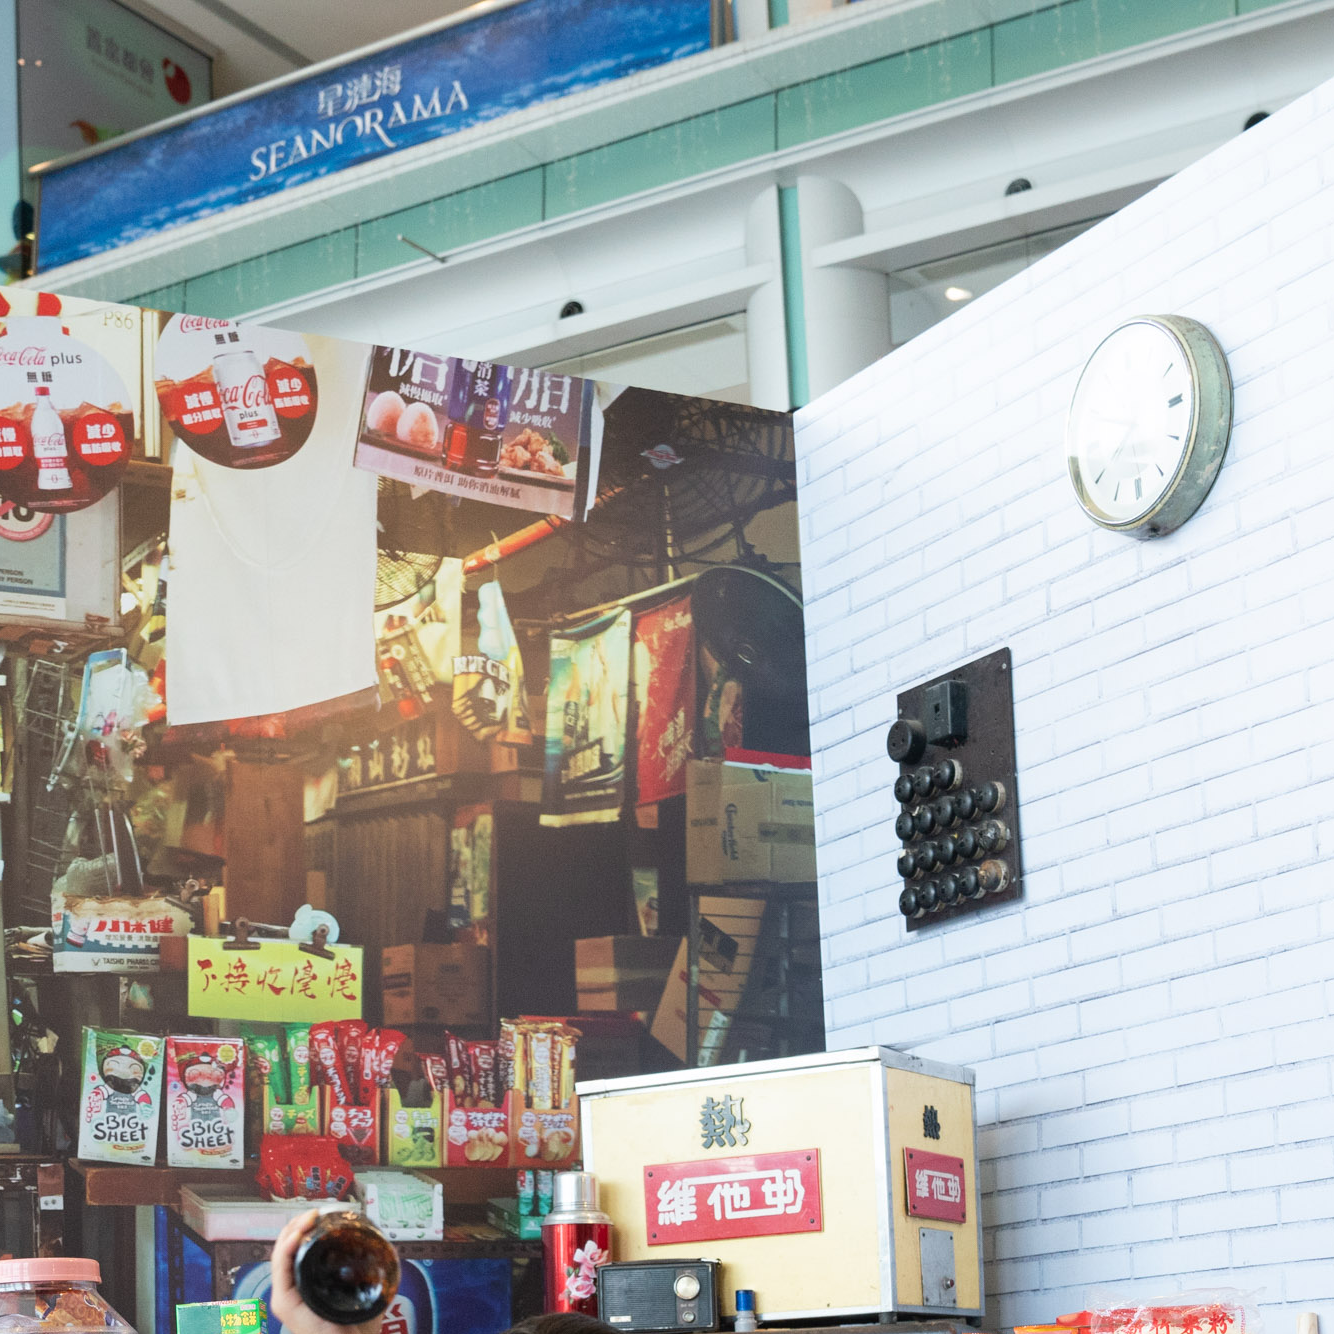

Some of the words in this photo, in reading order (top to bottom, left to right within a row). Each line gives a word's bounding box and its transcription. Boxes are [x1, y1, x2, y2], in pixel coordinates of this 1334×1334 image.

[248, 80, 470, 182] SEANORAMA
[50, 352, 83, 367] plus
[239, 411, 259, 421] plus
[104, 1113, 140, 1130] BIG
[190, 1119, 225, 1135] BIG
[698, 1094, 752, 1150] 熱
[922, 1104, 941, 1141] 熱
[656, 1168, 806, 1226] 維他奶
[914, 1168, 962, 1204] 維他奶
